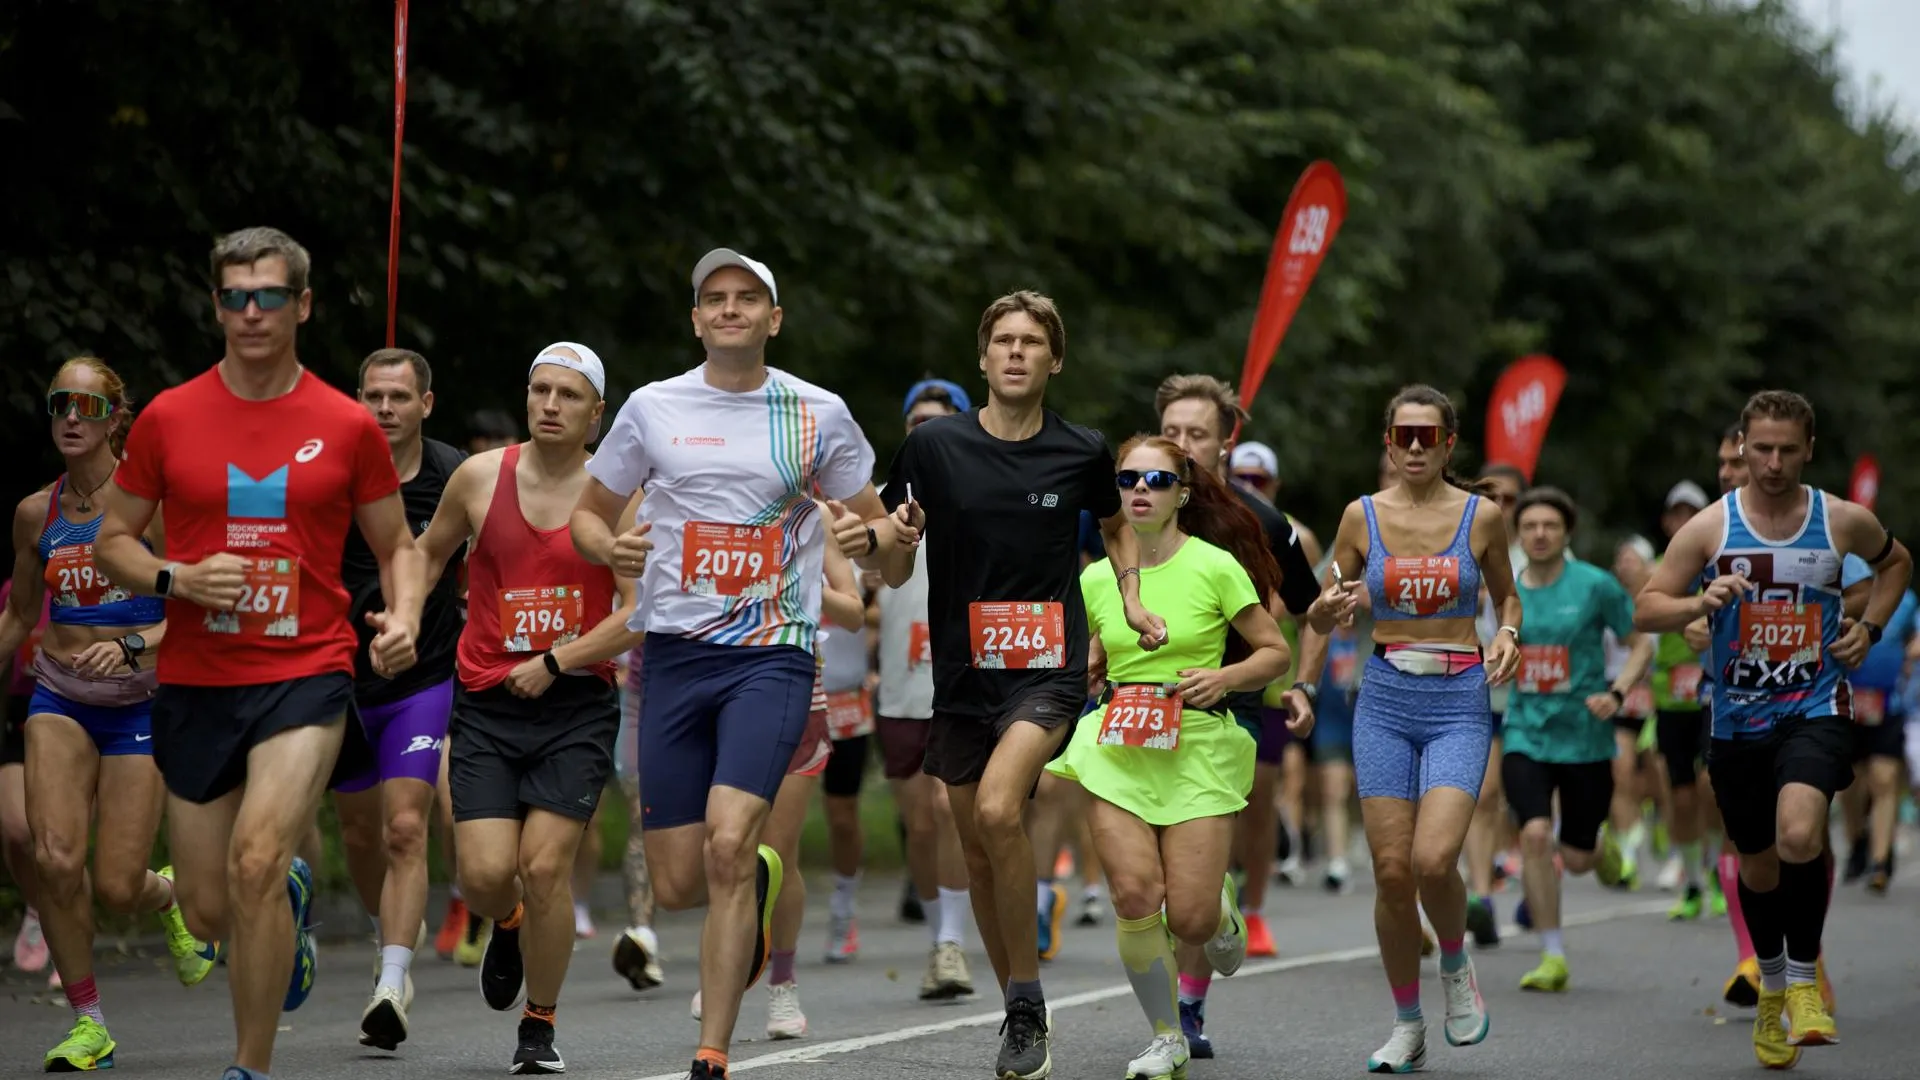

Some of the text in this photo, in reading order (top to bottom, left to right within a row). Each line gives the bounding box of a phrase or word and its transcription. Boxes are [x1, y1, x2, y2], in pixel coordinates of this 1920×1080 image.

[695, 548, 763, 578] 2079
[235, 584, 289, 614] 267
[1399, 577, 1451, 600] 2174
[515, 608, 565, 633] 2196
[982, 625, 1046, 650] 2246
[1750, 624, 1807, 646] 2027
[1108, 706, 1164, 731] 2273
